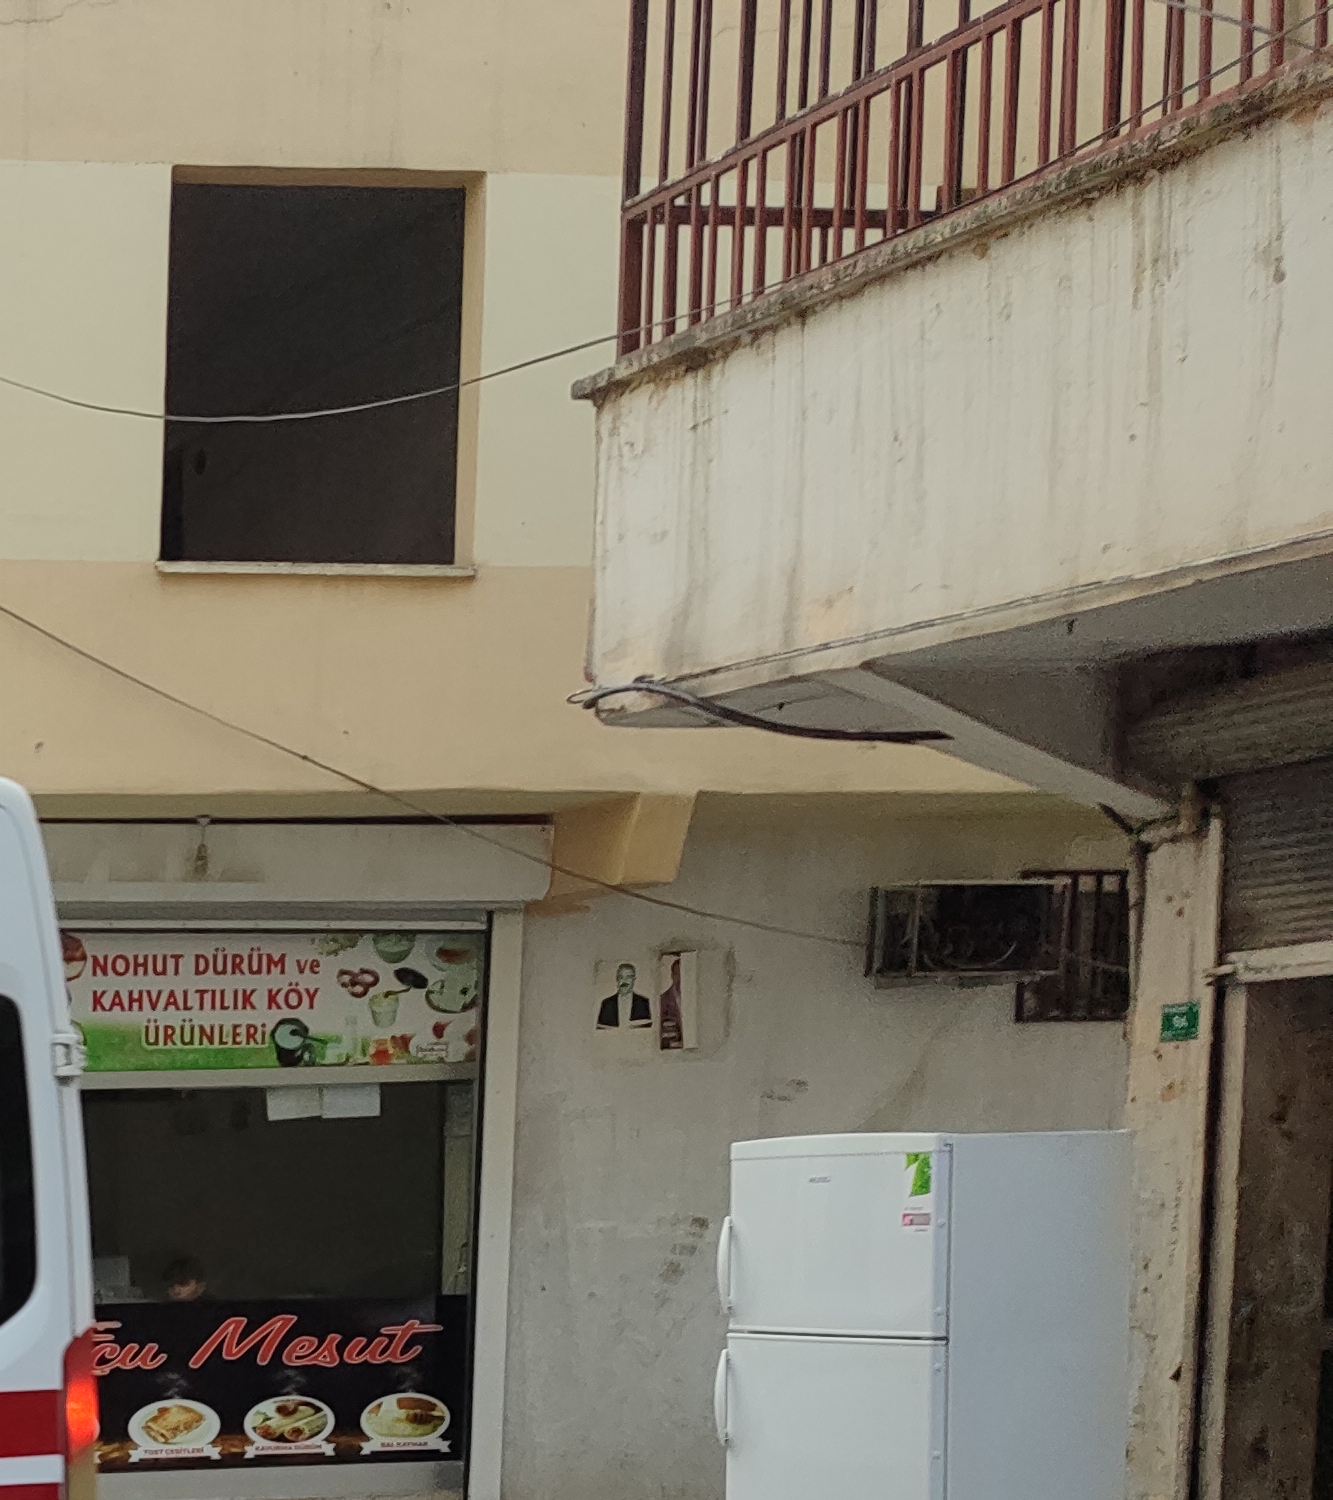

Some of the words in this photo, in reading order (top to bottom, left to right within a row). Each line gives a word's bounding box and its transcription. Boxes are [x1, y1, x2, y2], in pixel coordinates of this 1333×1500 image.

[90, 952, 185, 978] NOHUT
[193, 947, 287, 976] DÜRÜM
[295, 958, 321, 975] ve
[91, 987, 256, 1012] KAHVALTILIK
[267, 981, 321, 1011] KÖY
[189, 1314, 444, 1368] Mesut
